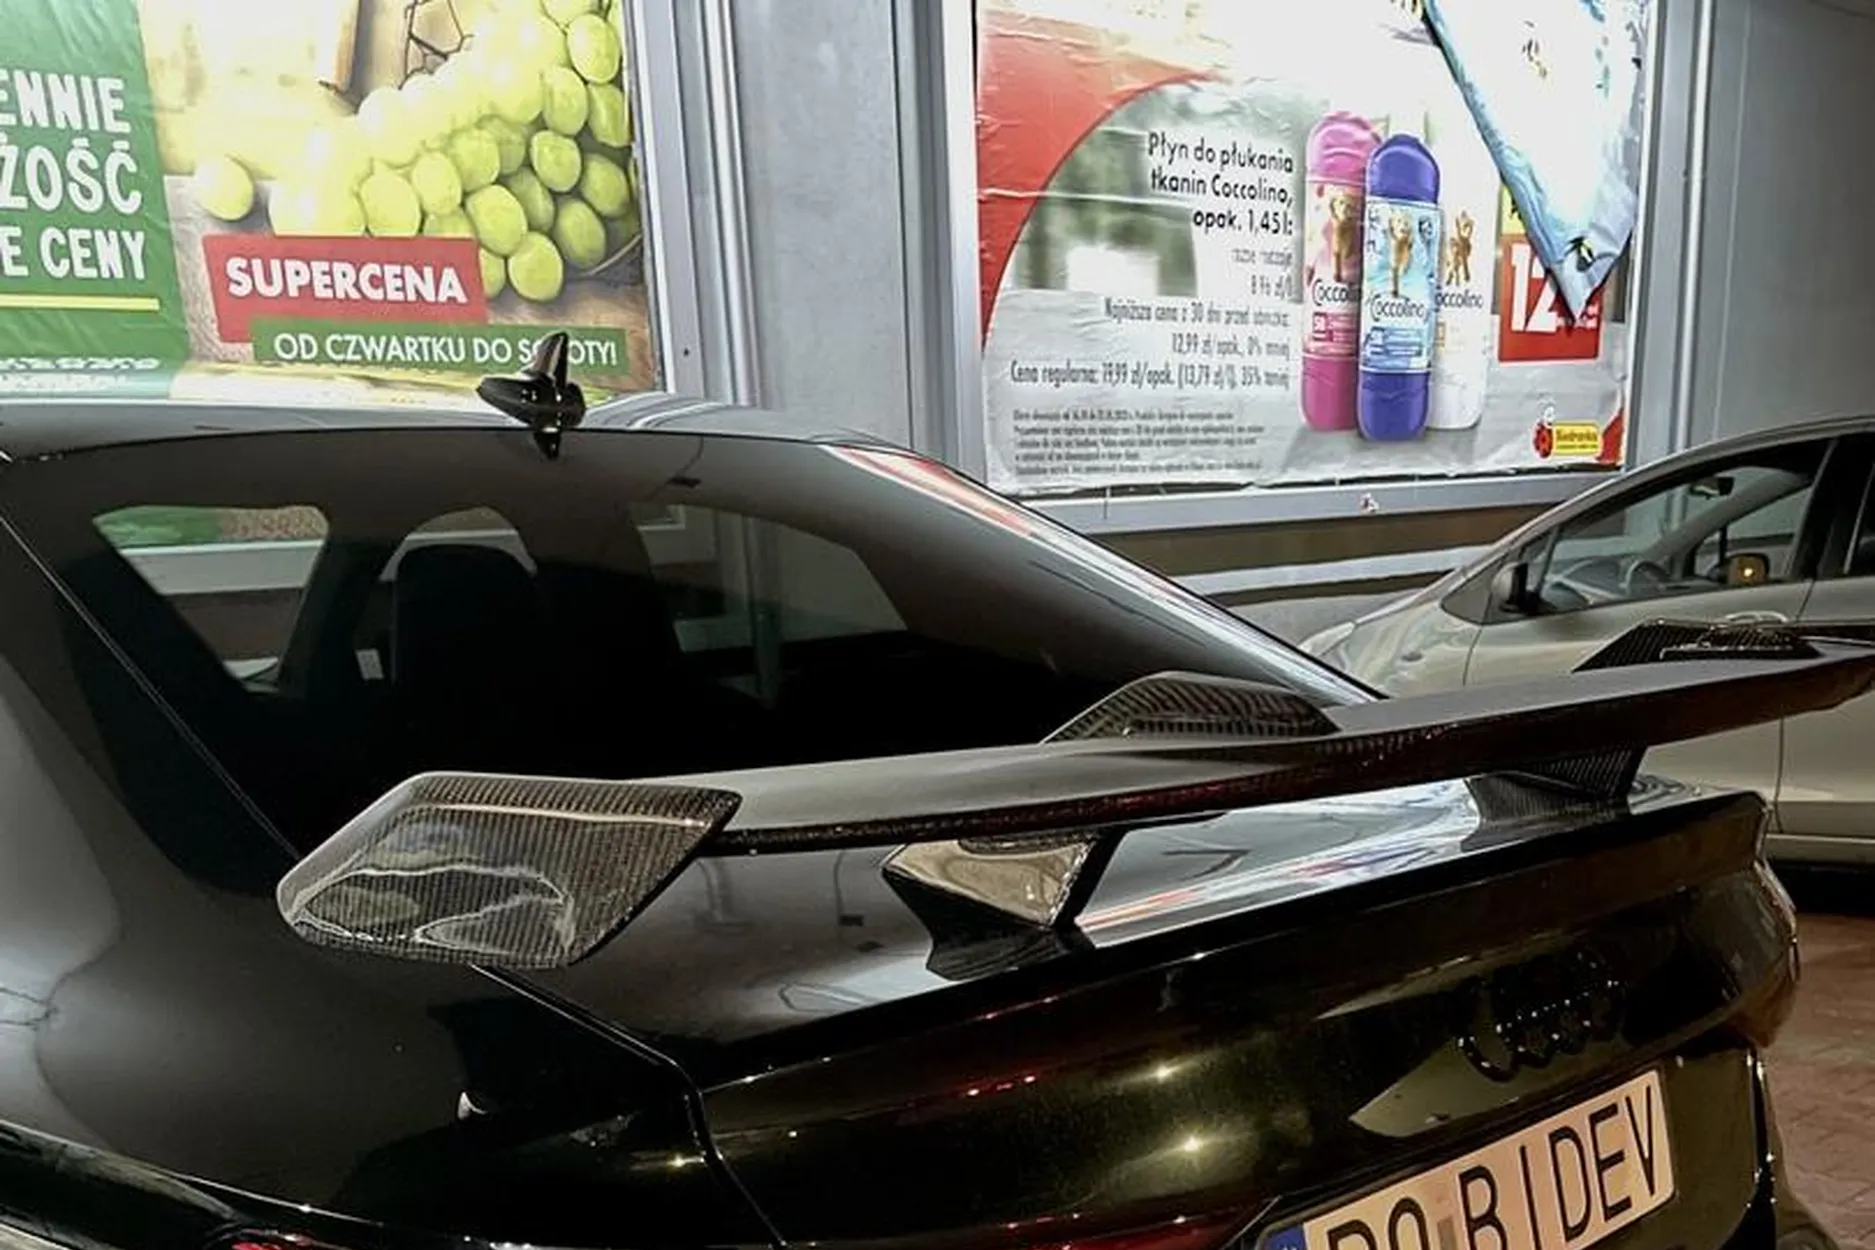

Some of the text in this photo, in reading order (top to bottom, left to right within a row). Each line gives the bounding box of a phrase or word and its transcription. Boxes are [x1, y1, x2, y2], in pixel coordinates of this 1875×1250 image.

[1149, 131, 1294, 173] Płyn do płukania
[1151, 165, 1293, 209] tkanin Coccolino,
[1193, 209, 1242, 235] opak.
[40, 227, 146, 280] CENY
[226, 257, 468, 304] SUPERCENA
[274, 332, 618, 367] OD CZWARTKU DO SOTY!
